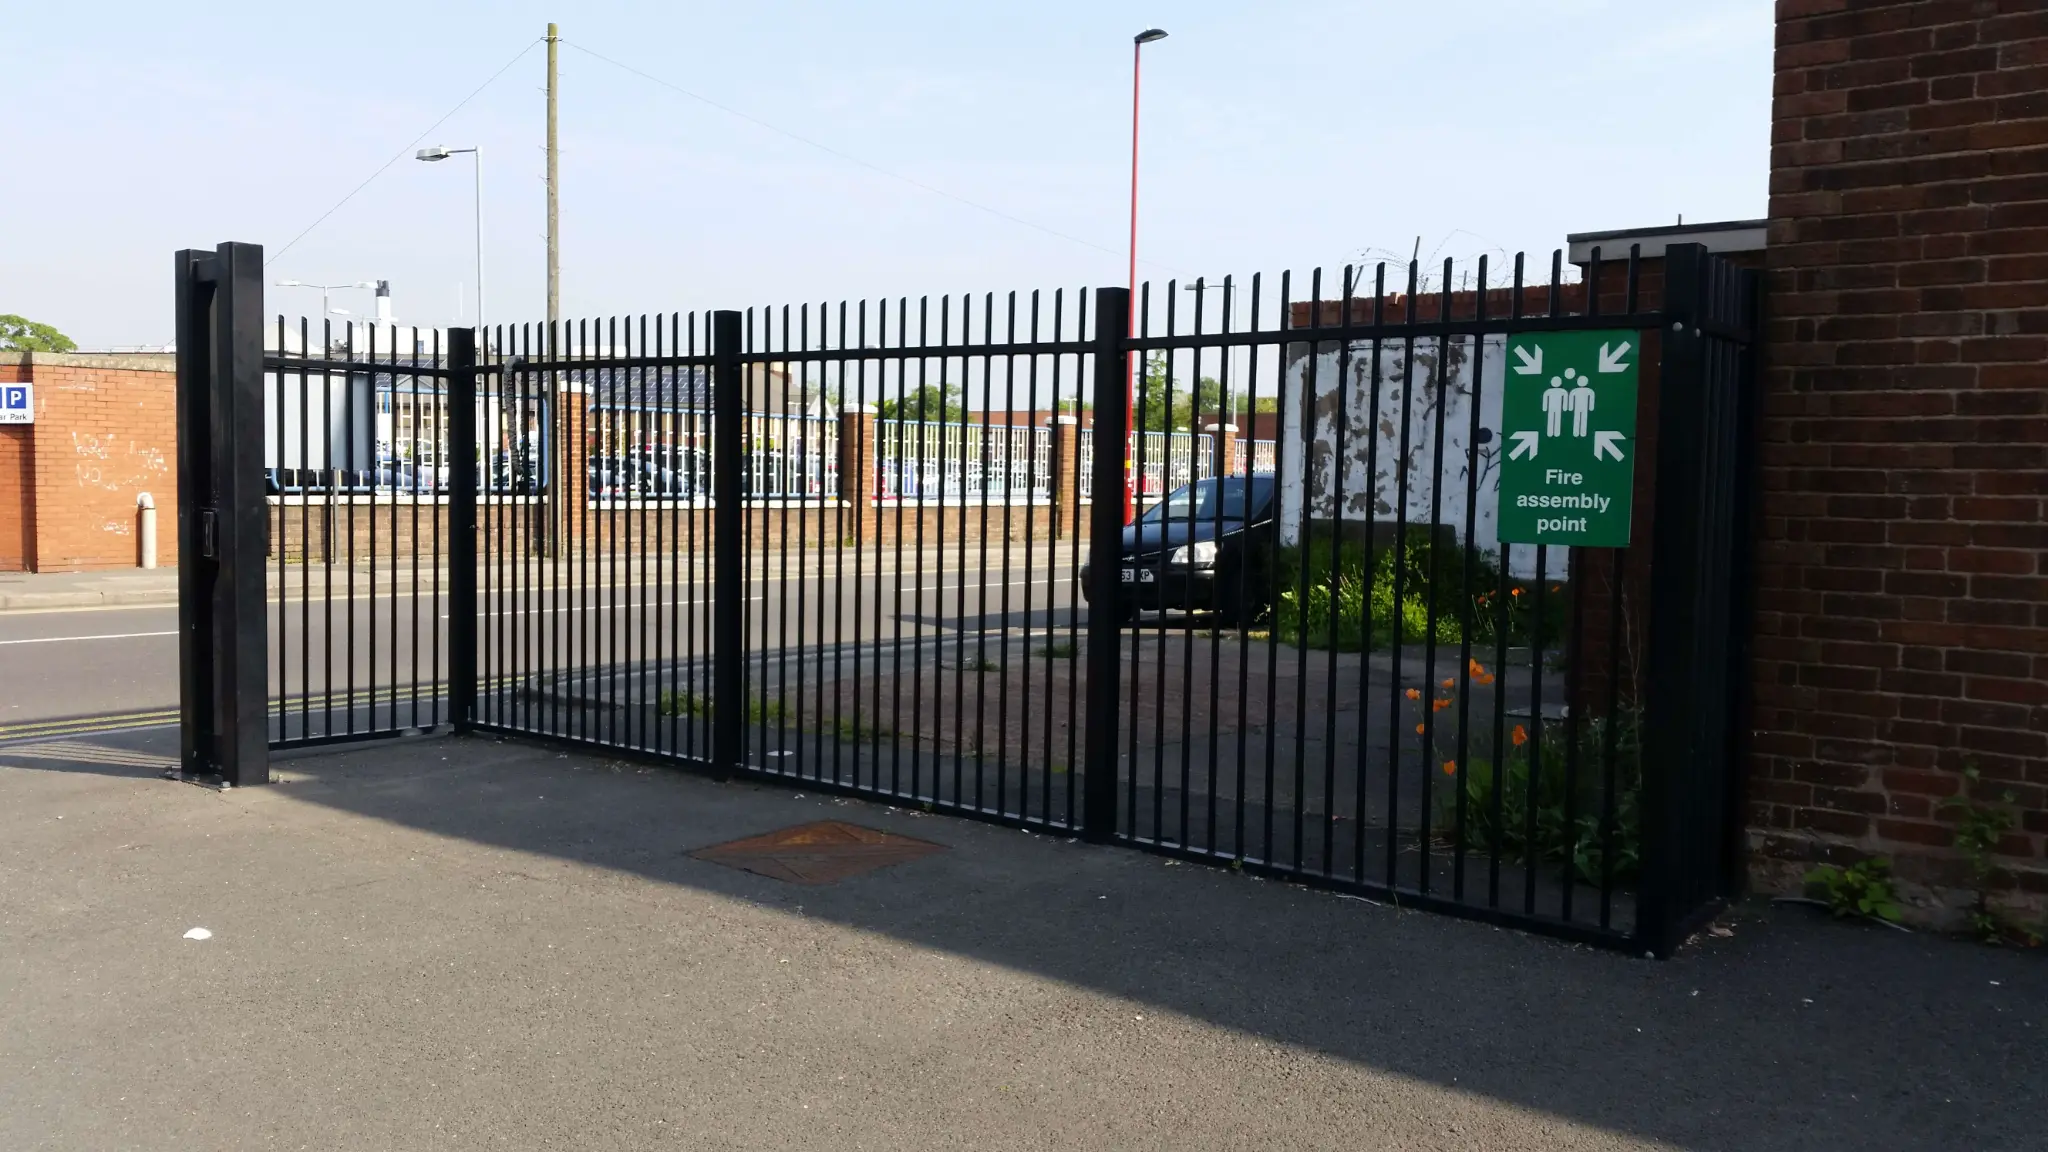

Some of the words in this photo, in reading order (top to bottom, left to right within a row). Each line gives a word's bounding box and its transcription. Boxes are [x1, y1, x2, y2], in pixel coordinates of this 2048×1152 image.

[10, 390, 22, 406] P
[10, 413, 27, 421] Park
[1545, 469, 1584, 486] Fire
[1516, 493, 1611, 514] assembly
[1536, 516, 1588, 535] point
